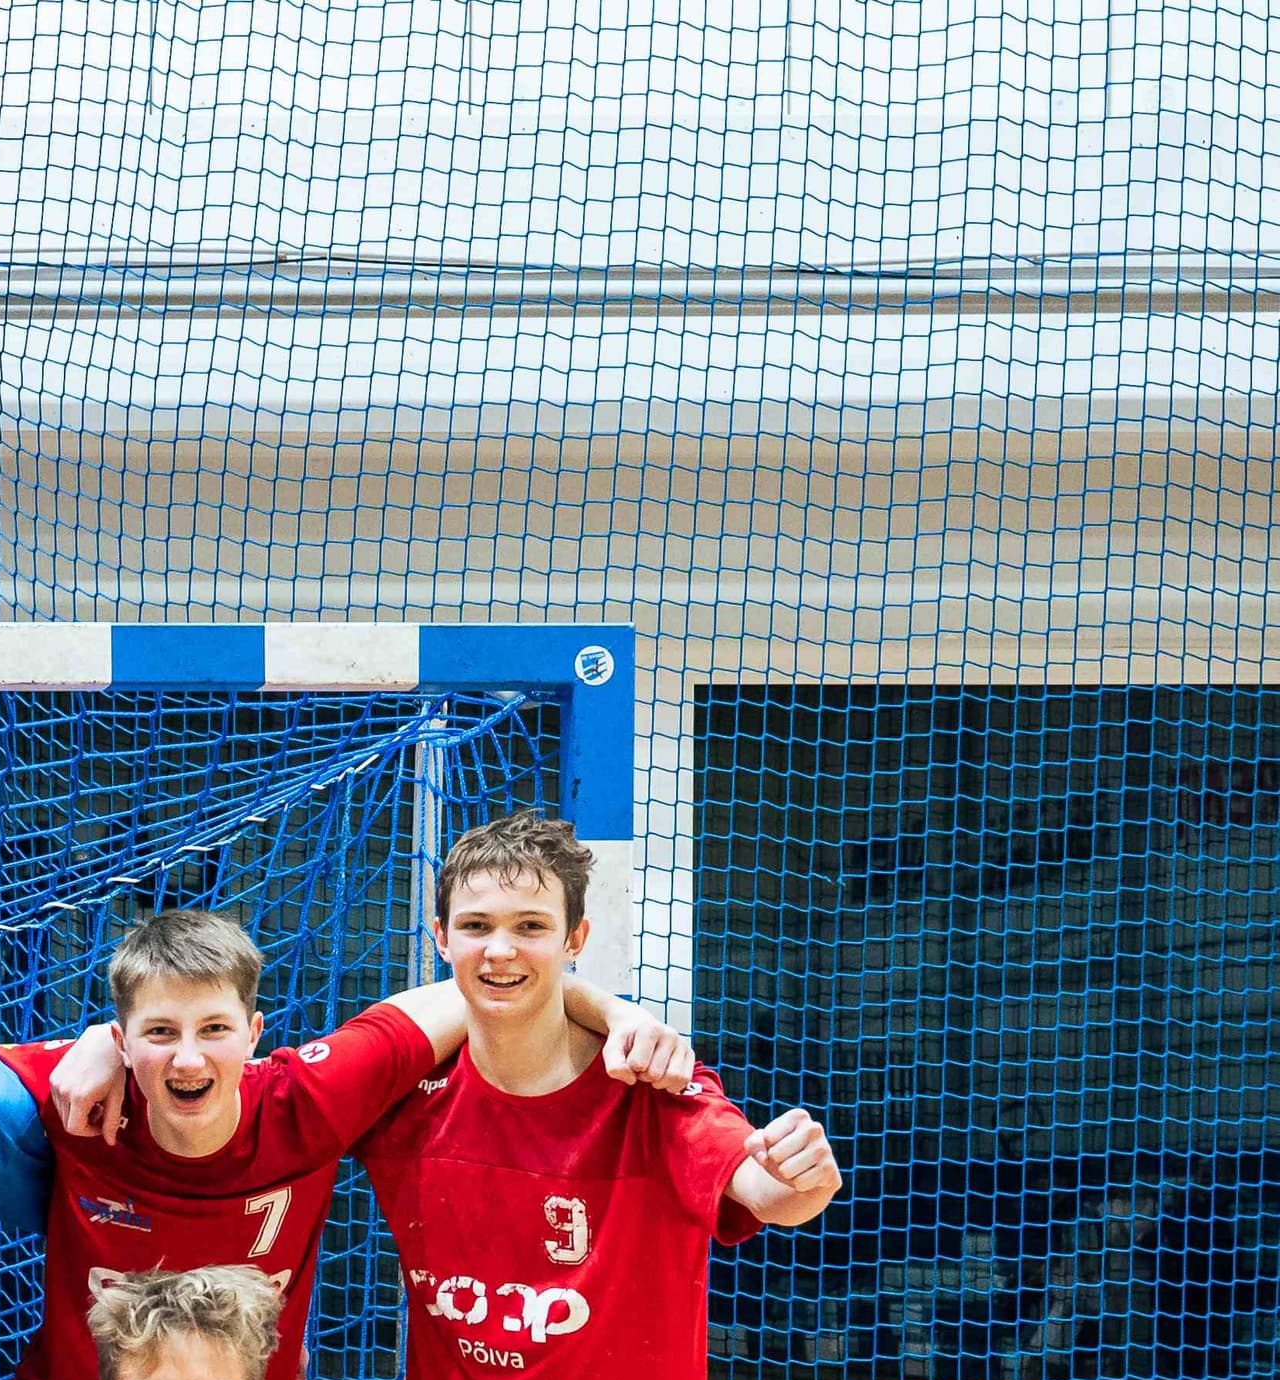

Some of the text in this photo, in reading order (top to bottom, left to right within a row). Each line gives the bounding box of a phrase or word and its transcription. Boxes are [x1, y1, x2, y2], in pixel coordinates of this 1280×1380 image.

[244, 1186, 292, 1258] 7
[542, 1192, 592, 1266] 9
[458, 1338, 525, 1369] Põlva
